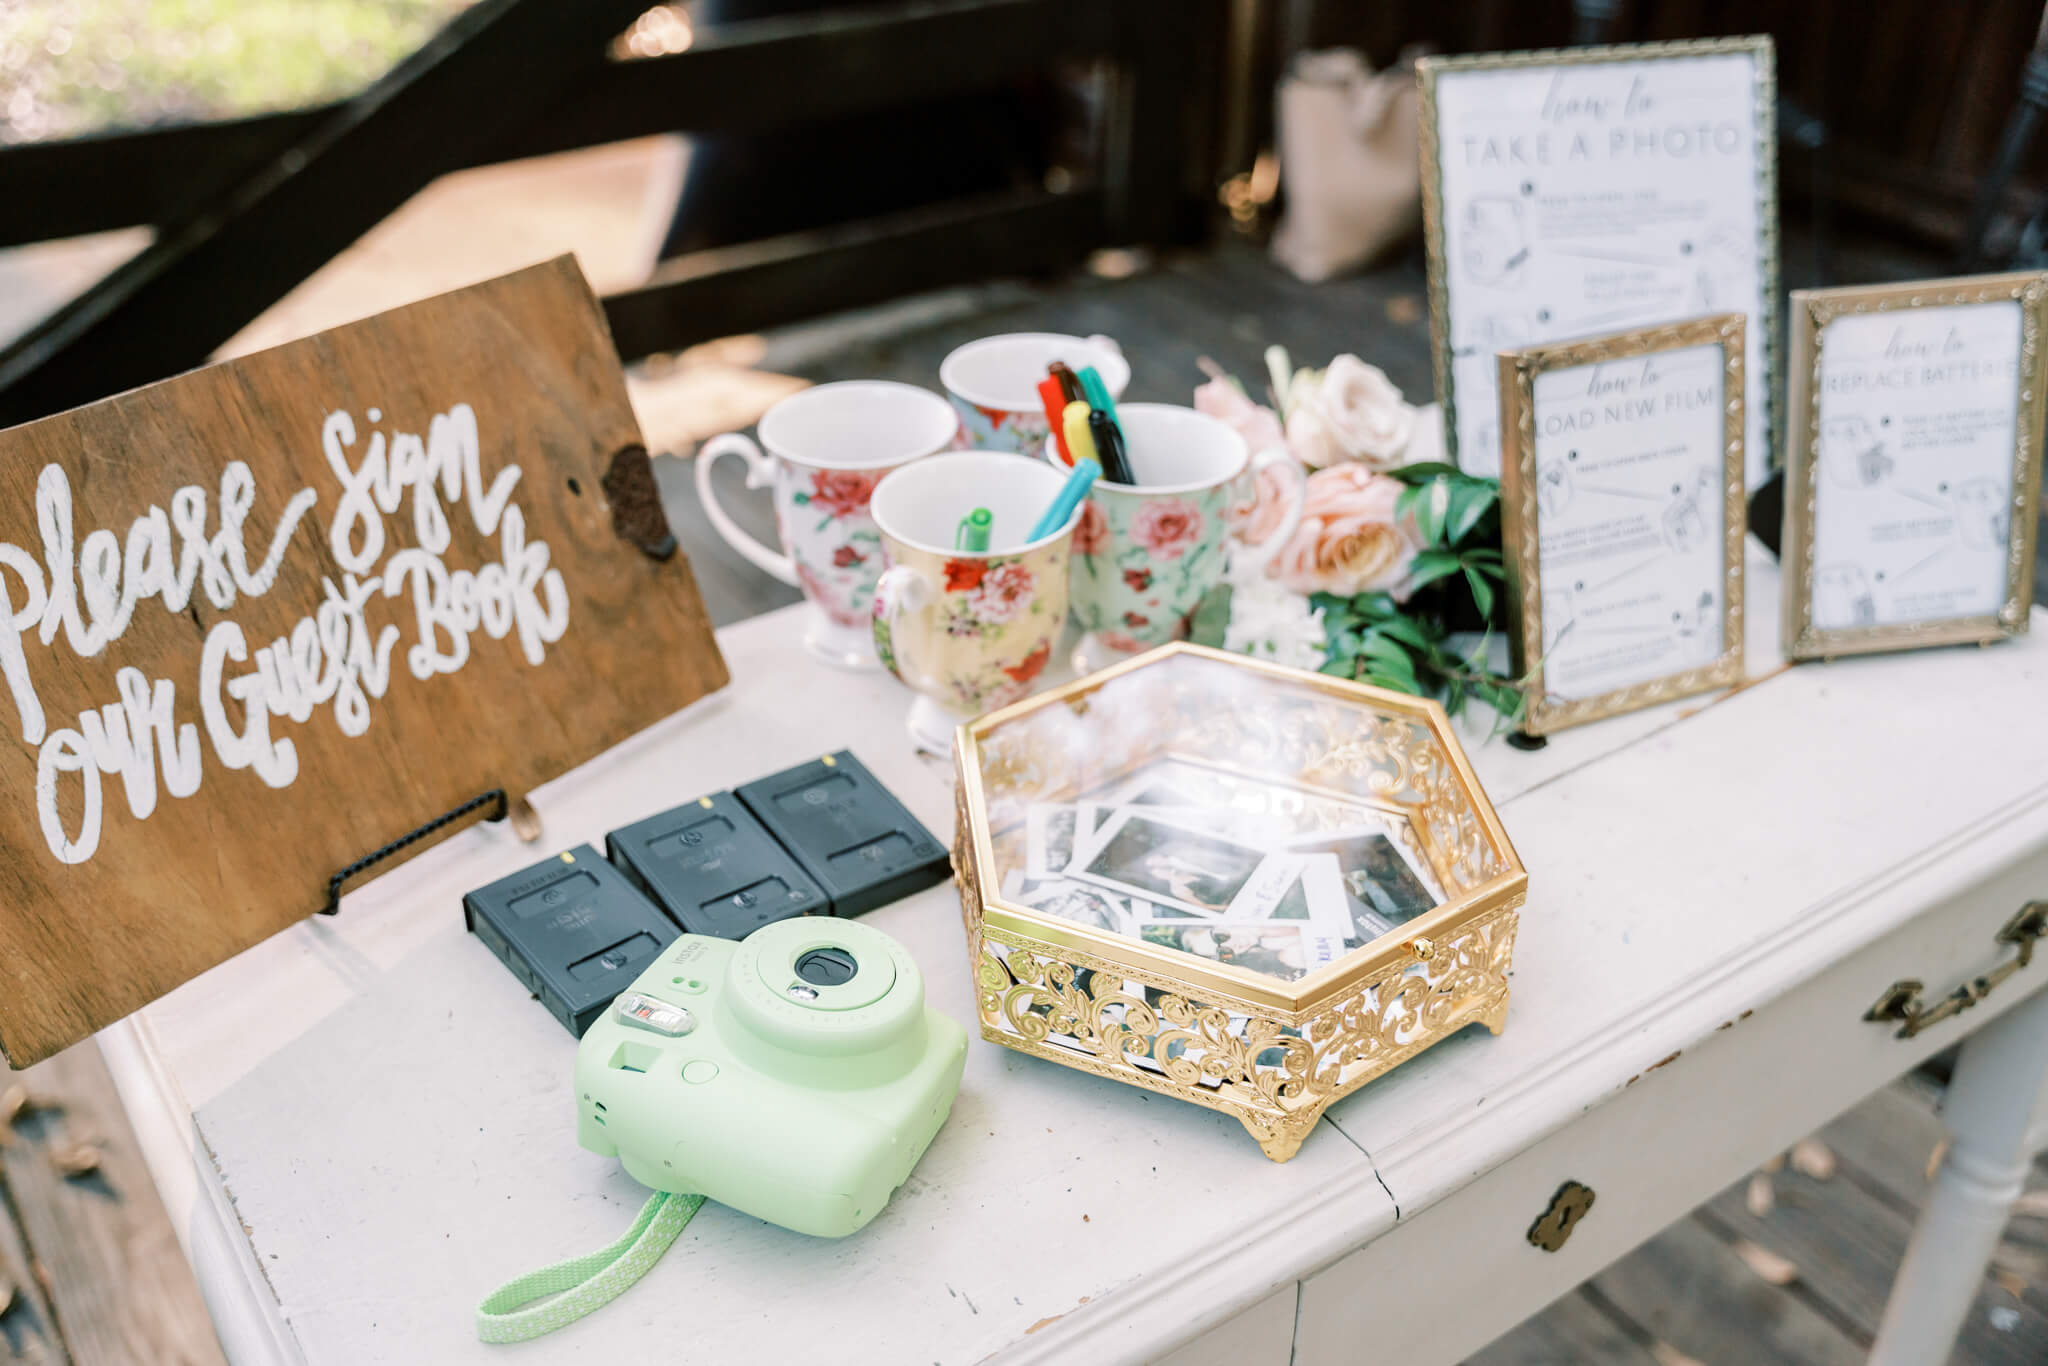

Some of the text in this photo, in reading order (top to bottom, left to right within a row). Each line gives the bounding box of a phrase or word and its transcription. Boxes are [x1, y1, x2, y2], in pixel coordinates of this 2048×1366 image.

[1463, 120, 1740, 168] TAKE A PHOTO
[1586, 358, 1660, 399] how to
[1826, 358, 2019, 393] REPLACE BATTERIE
[1535, 386, 1714, 439] LOAD NEW FILM
[200, 573, 400, 788] Guest
[383, 502, 570, 681] Book
